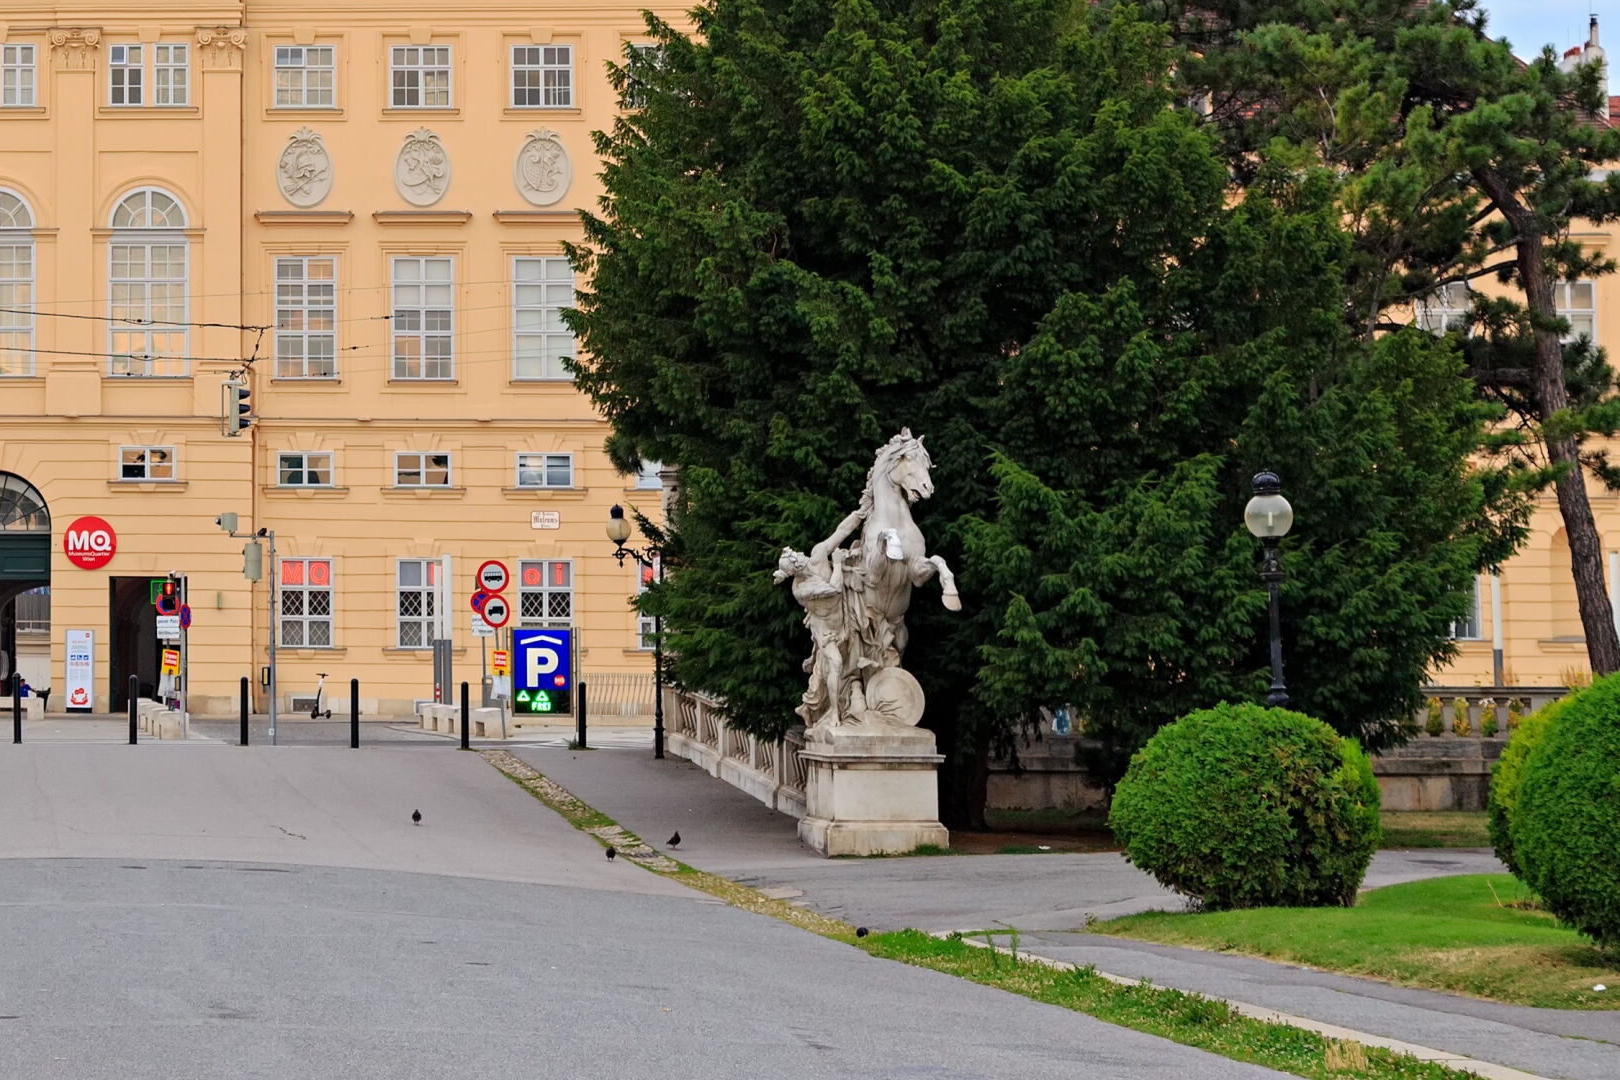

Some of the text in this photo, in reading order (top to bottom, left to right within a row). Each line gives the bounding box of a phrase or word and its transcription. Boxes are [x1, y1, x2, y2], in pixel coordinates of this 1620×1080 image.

[68, 530, 112, 551] MQ
[282, 562, 330, 586] MQ
[526, 647, 559, 688] P
[531, 701, 552, 712] FREI
